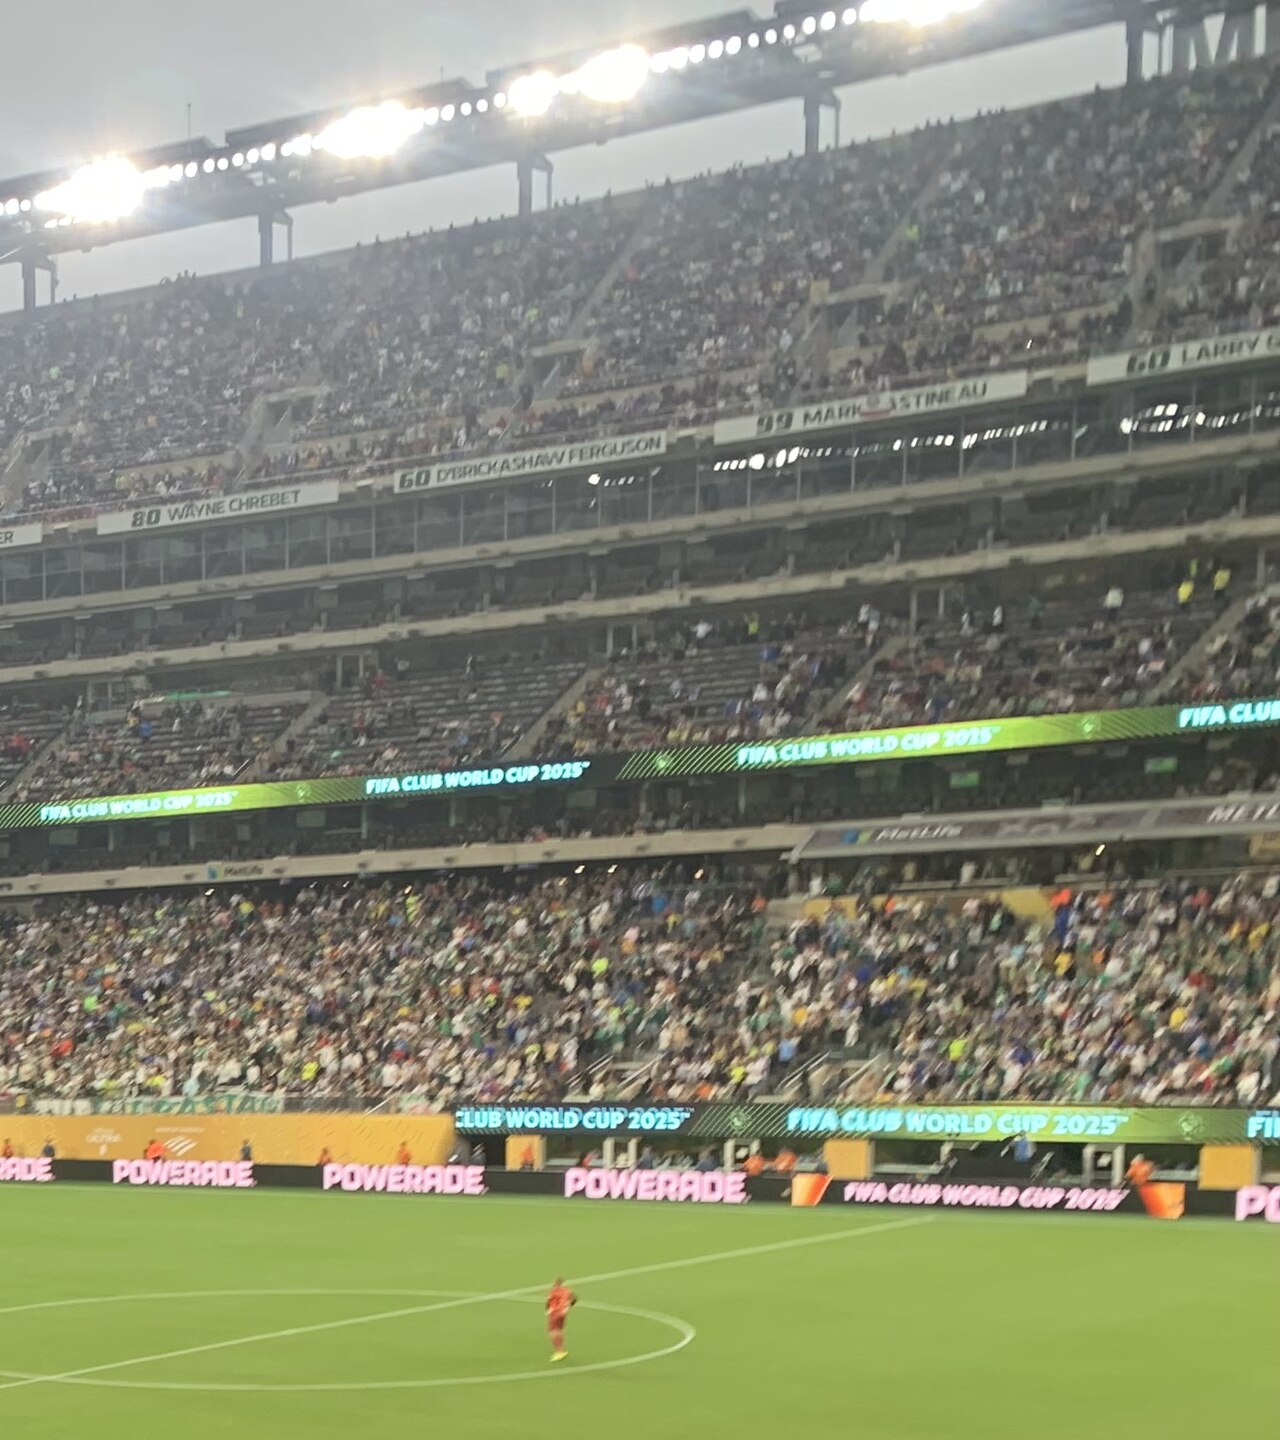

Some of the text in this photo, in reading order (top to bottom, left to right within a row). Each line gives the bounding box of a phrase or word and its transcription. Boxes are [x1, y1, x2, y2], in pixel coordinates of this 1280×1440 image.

[756, 383, 987, 433] 99 MARK ASTINEAU
[399, 470, 431, 489] 60
[569, 436, 661, 465] FERGUSON
[131, 490, 301, 528] 80 WAYNE CHREBET
[1178, 705, 1227, 728] FIFA
[738, 743, 779, 765] FIFA
[780, 739, 827, 762] CLUB
[830, 734, 898, 758] WORLD
[900, 730, 940, 751] CUP
[365, 777, 401, 795] FIFA
[402, 774, 443, 792] CLUB
[445, 769, 504, 789] WORLD
[505, 766, 540, 784] CUP
[40, 805, 71, 821] FIFA
[72, 803, 108, 818] CLUB
[110, 798, 161, 815] WORLD
[163, 796, 193, 810] CUP
[506, 1110, 578, 1129] WORLD
[582, 1110, 624, 1129] CUP
[786, 1108, 840, 1131] FIFA
[841, 1110, 903, 1132] CLUB
[905, 1112, 991, 1134] WORLD
[996, 1112, 1048, 1134] CUP
[113, 1159, 256, 1187] POWERADE
[323, 1164, 486, 1195] POWERADE
[565, 1168, 749, 1203] POWERADE
[844, 1182, 888, 1202] FIFA
[888, 1183, 941, 1205] CLUB
[941, 1184, 1013, 1207] WORLD
[1017, 1185, 1065, 1209] CUP
